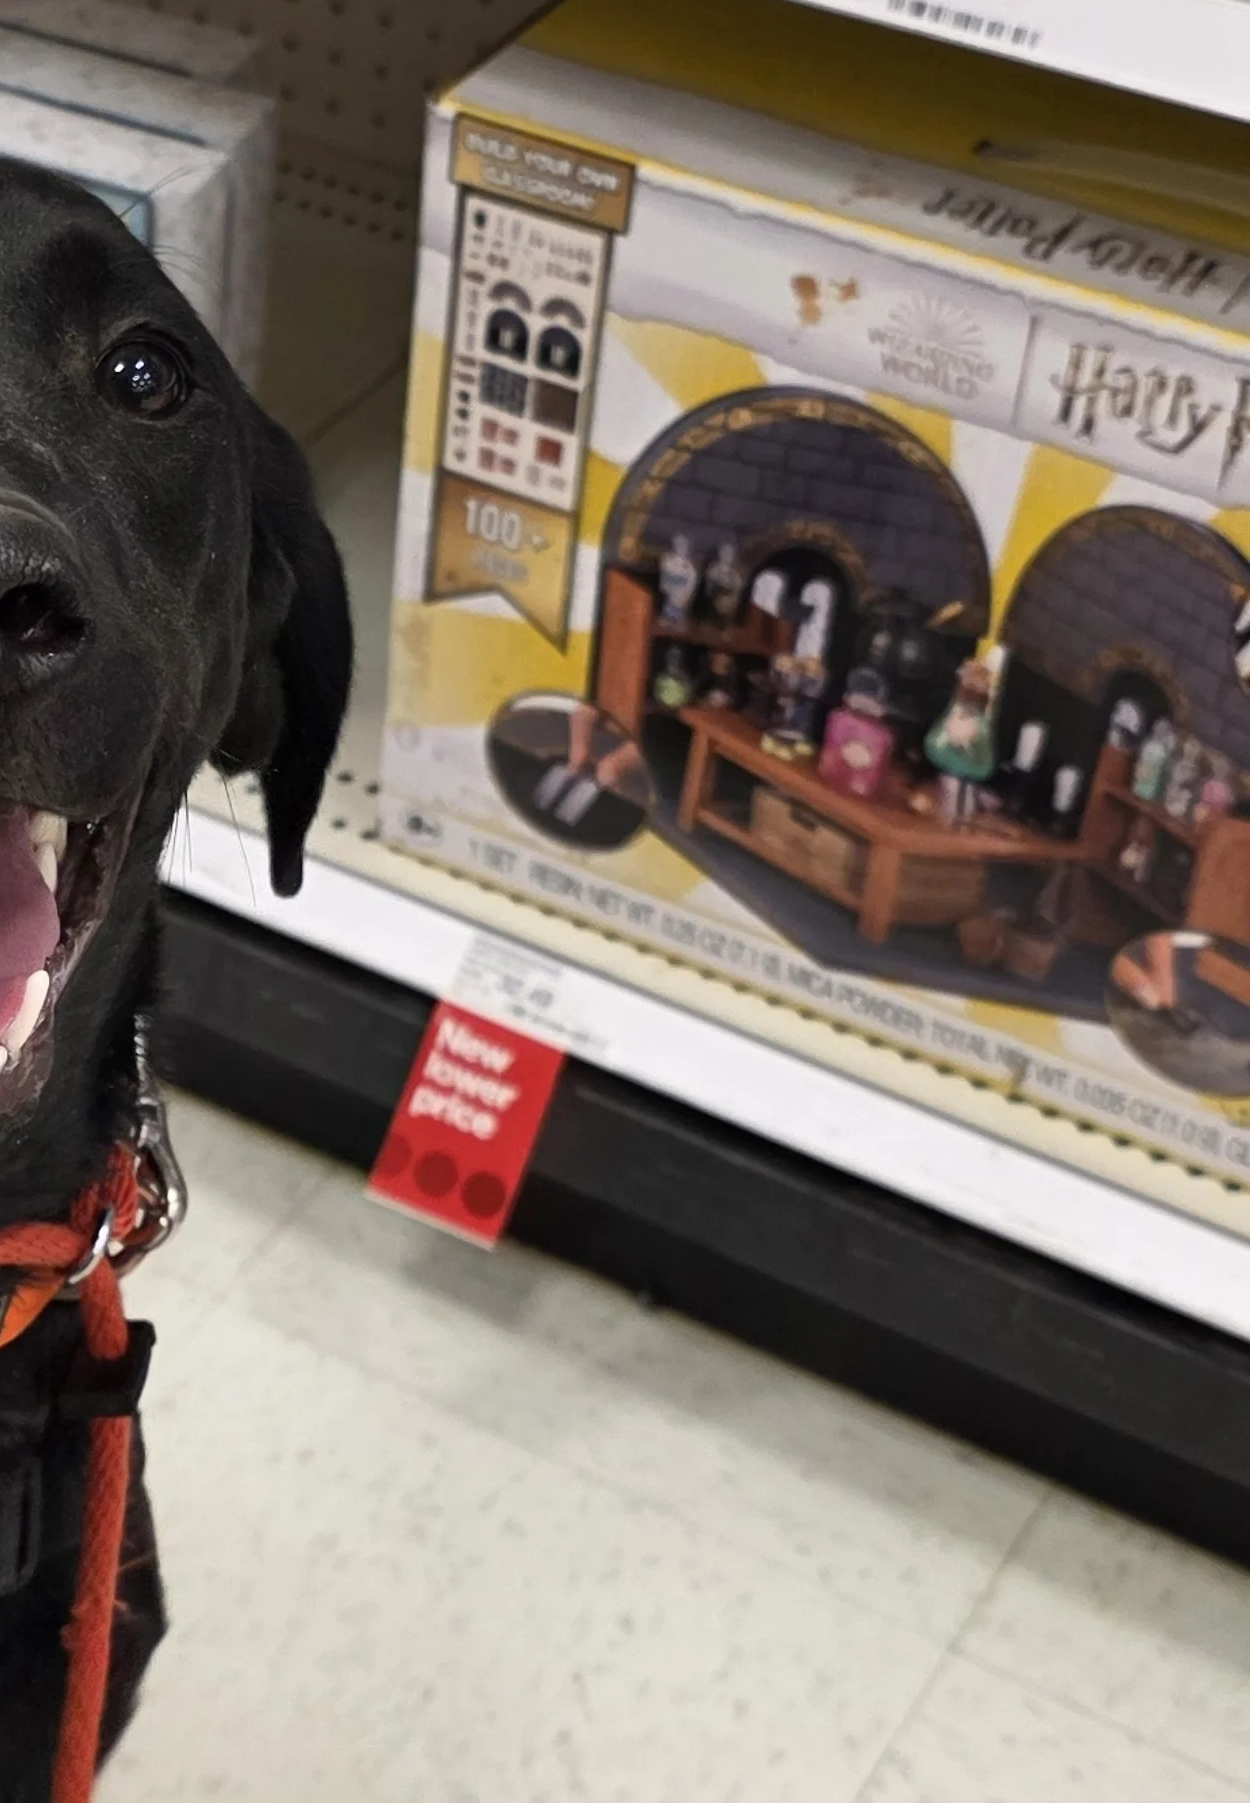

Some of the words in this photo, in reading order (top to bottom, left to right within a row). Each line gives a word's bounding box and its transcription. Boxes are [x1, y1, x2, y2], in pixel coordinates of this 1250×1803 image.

[1050, 342, 1222, 455] Harry
[435, 1017, 515, 1074] New
[422, 1051, 520, 1113] lower
[408, 1084, 498, 1141] price
